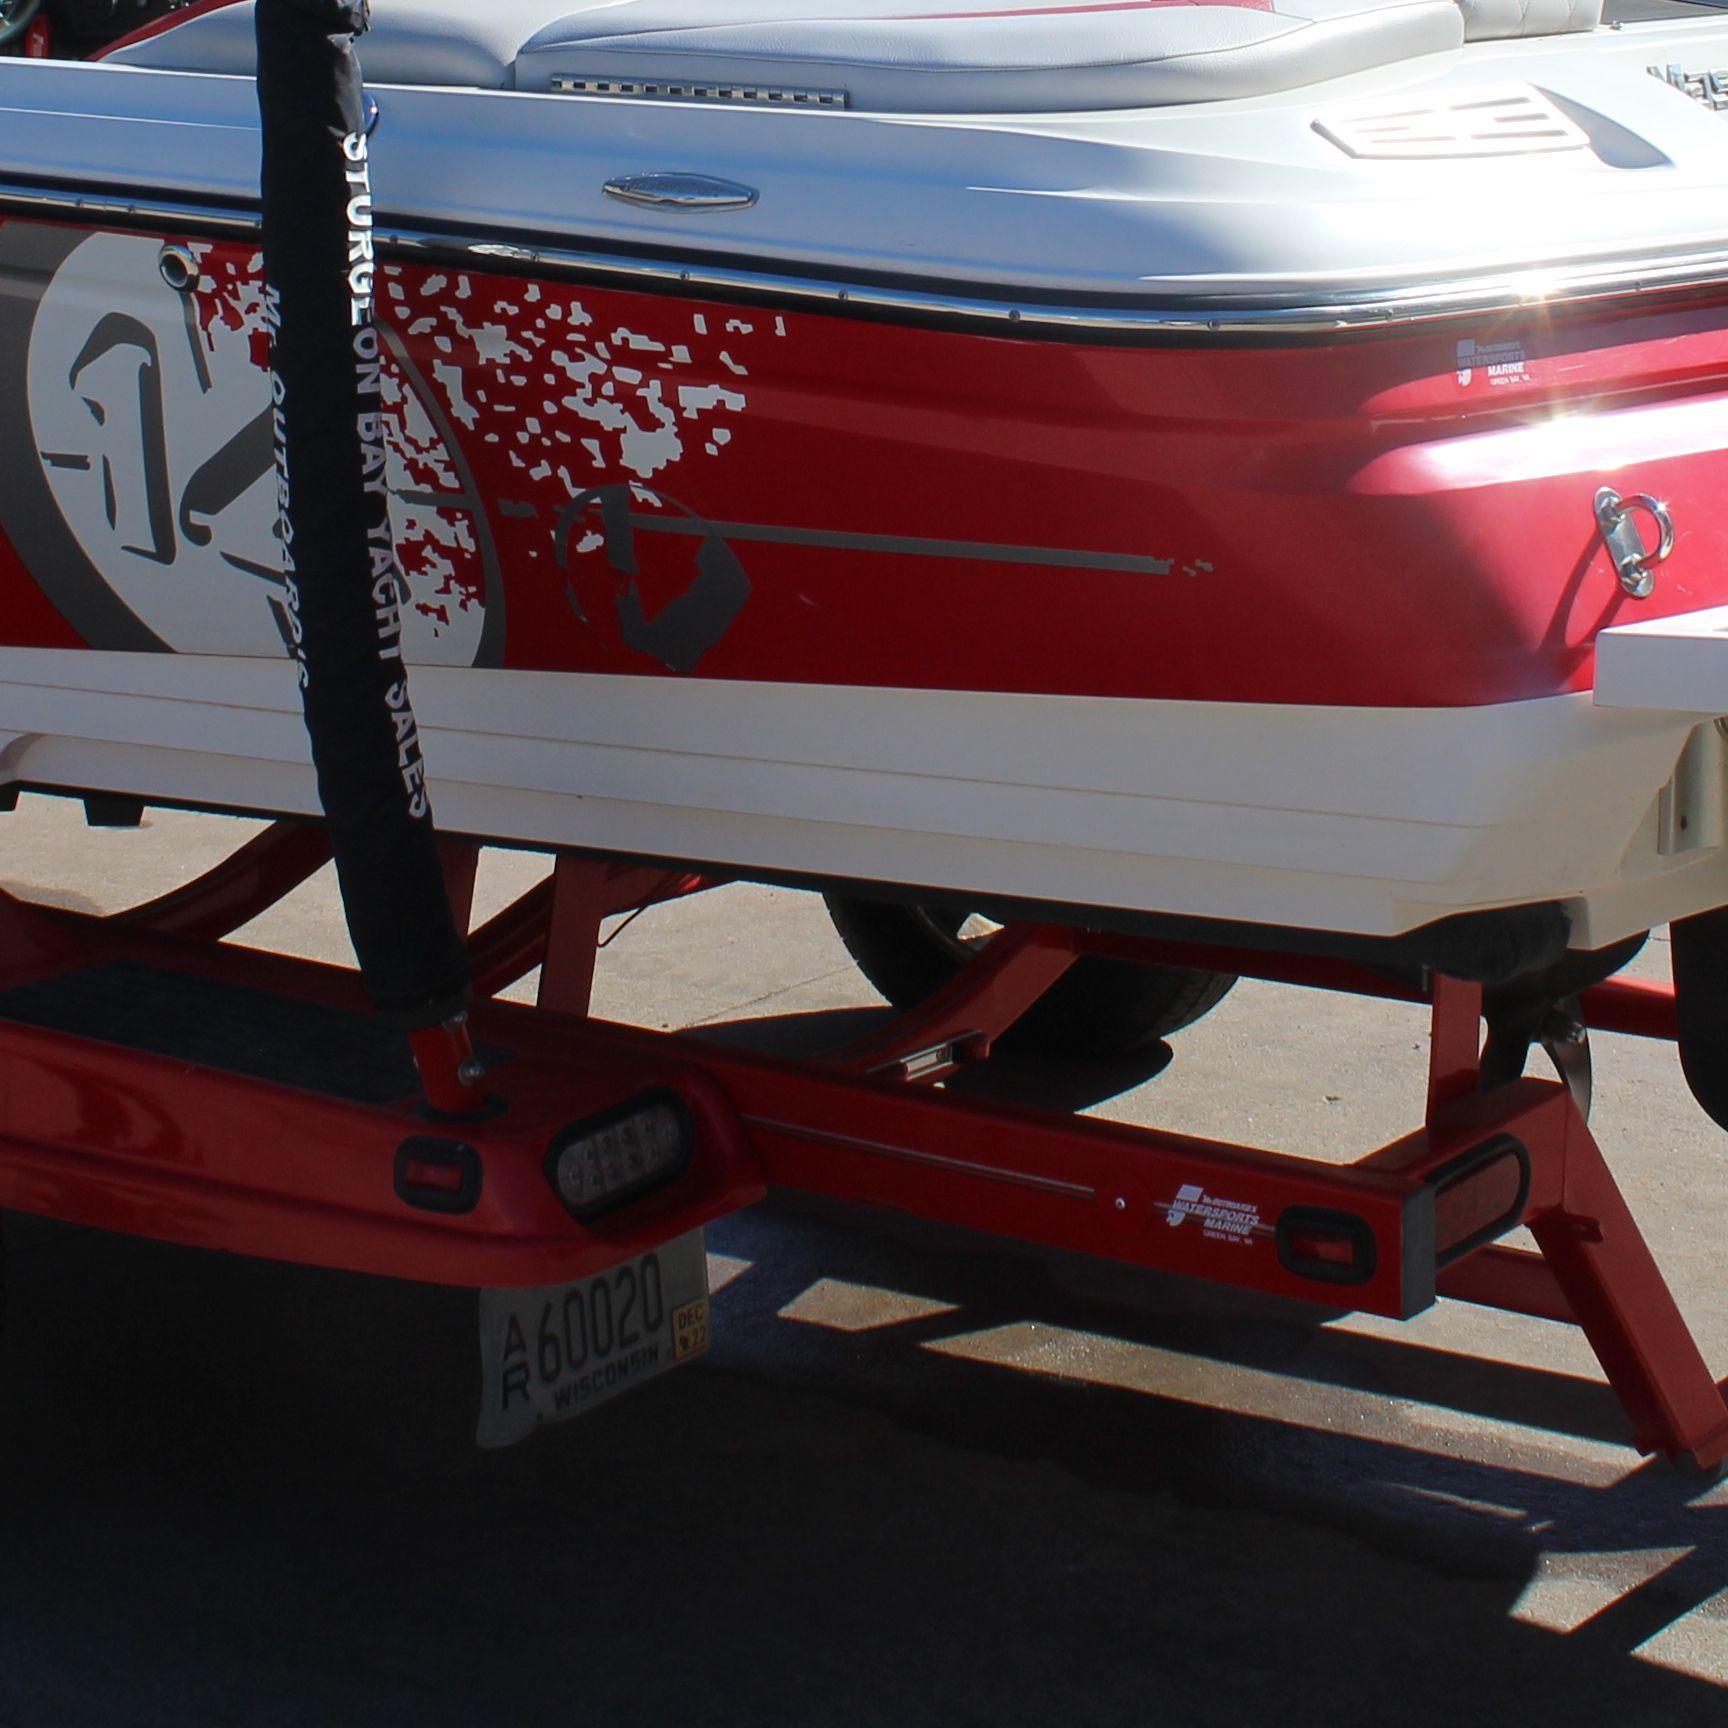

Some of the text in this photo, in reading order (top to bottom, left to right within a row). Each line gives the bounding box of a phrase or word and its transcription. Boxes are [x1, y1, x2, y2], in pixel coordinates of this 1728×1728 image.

[341, 131, 432, 820] STURGEON BAY YACHT SALES
[1171, 1199, 1261, 1225] WATERSPORTS
[1202, 1217, 1253, 1236] MARINE
[537, 1251, 664, 1384] 60020
[677, 1302, 705, 1329] DEC
[691, 1325, 707, 1348] 22
[553, 1344, 661, 1411] WISCONSIN
